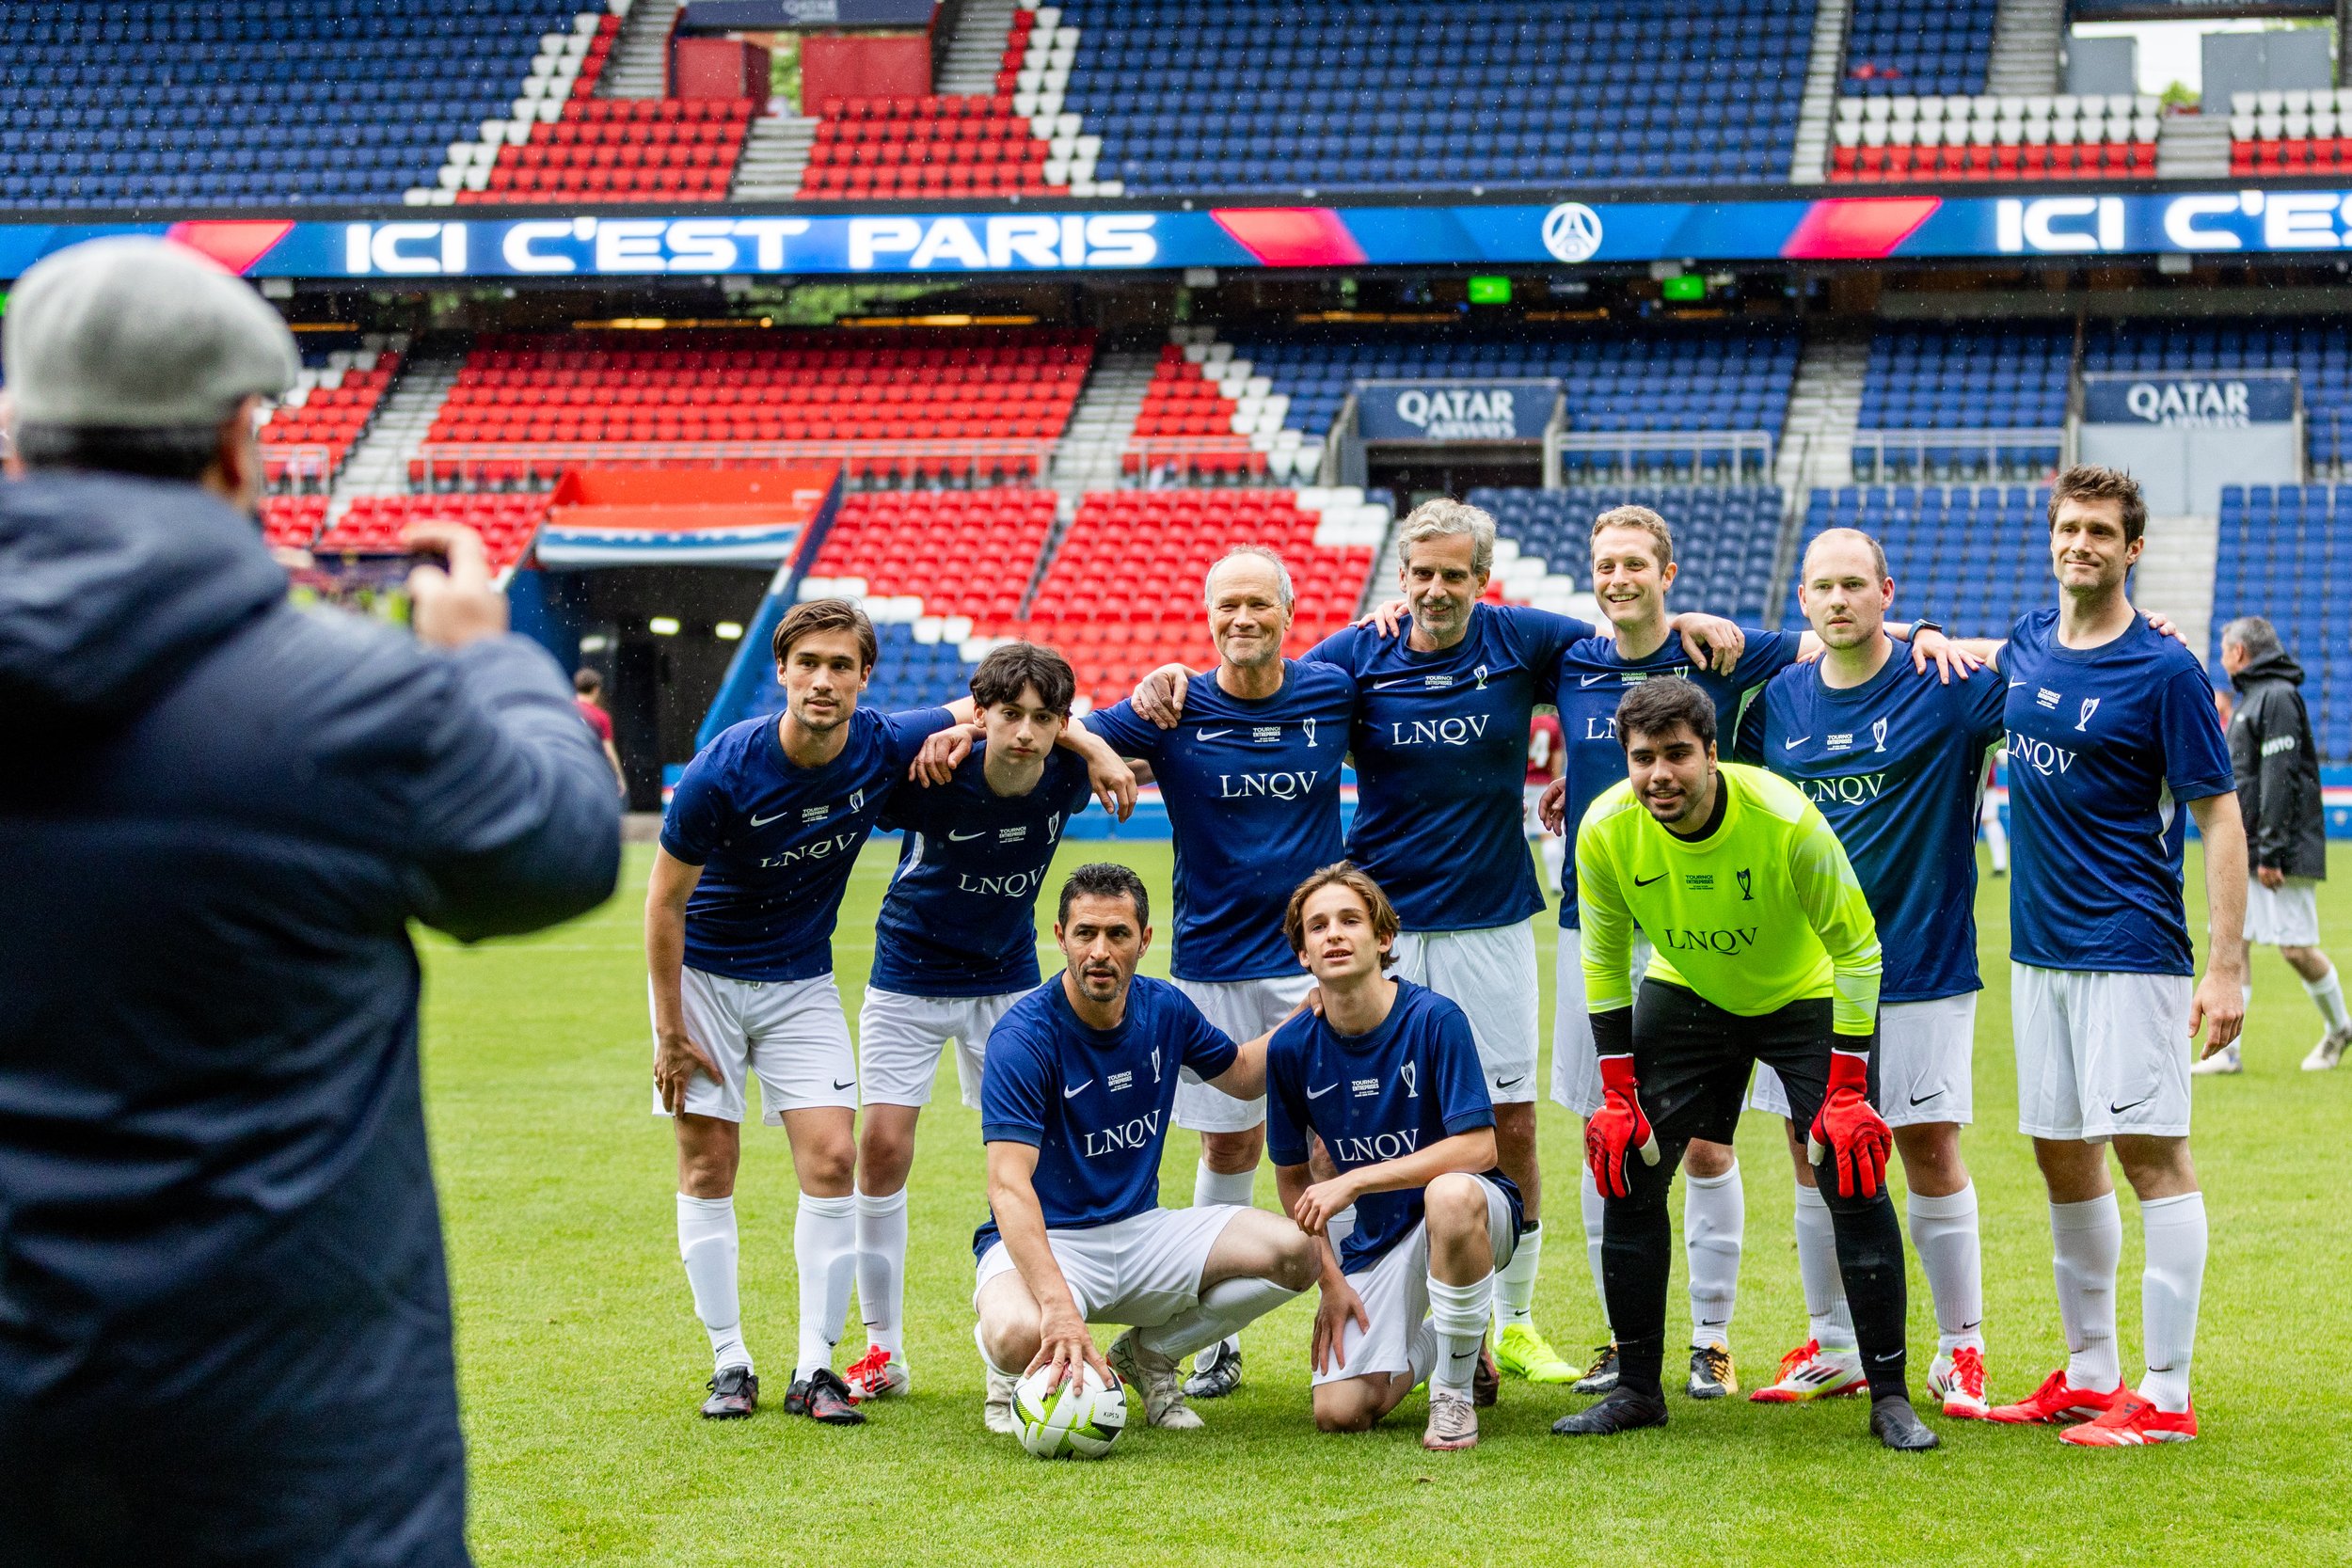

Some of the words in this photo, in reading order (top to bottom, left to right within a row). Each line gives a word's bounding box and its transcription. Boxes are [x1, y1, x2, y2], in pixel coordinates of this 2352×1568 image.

[1996, 197, 2125, 251] ICI
[2164, 190, 2352, 248] C'E
[346, 222, 468, 274] ICI
[502, 216, 809, 272] C'EST
[848, 214, 1156, 269] PARIS
[1396, 389, 1515, 427] QATAR
[2126, 382, 2249, 421] QATAR
[1391, 714, 1490, 746] LNQV
[2005, 728, 2077, 776] LNQV
[1219, 770, 1318, 800] LNQV
[1797, 773, 1886, 806] LNQV
[760, 832, 858, 867] LNQV
[958, 863, 1046, 897] LNQV
[1663, 927, 1759, 956] LNQV
[1084, 1109, 1161, 1157] LNQV
[1334, 1129, 1420, 1161] LNQV
